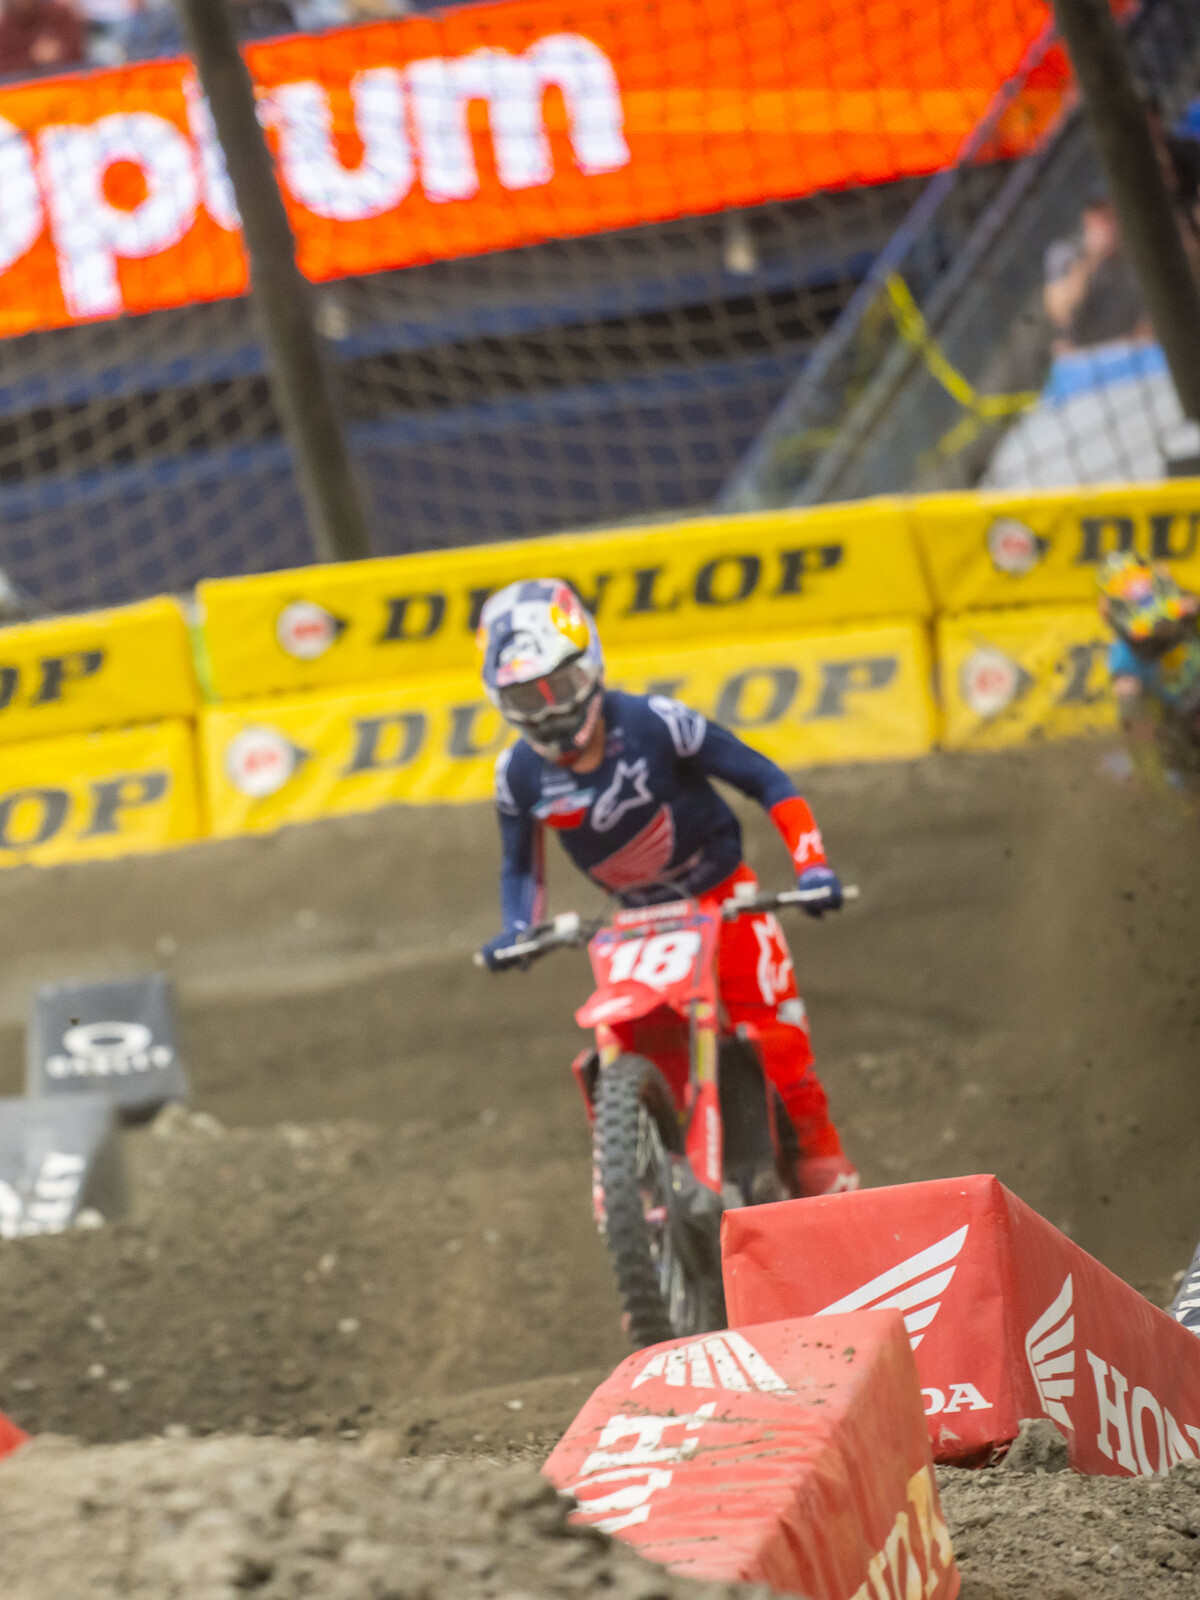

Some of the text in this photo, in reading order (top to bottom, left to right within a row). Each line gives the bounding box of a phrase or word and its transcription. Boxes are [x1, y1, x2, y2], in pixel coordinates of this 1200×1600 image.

[375, 545, 844, 646] DLOP
[340, 658, 898, 775] DUOP
[608, 931, 702, 986] 18
